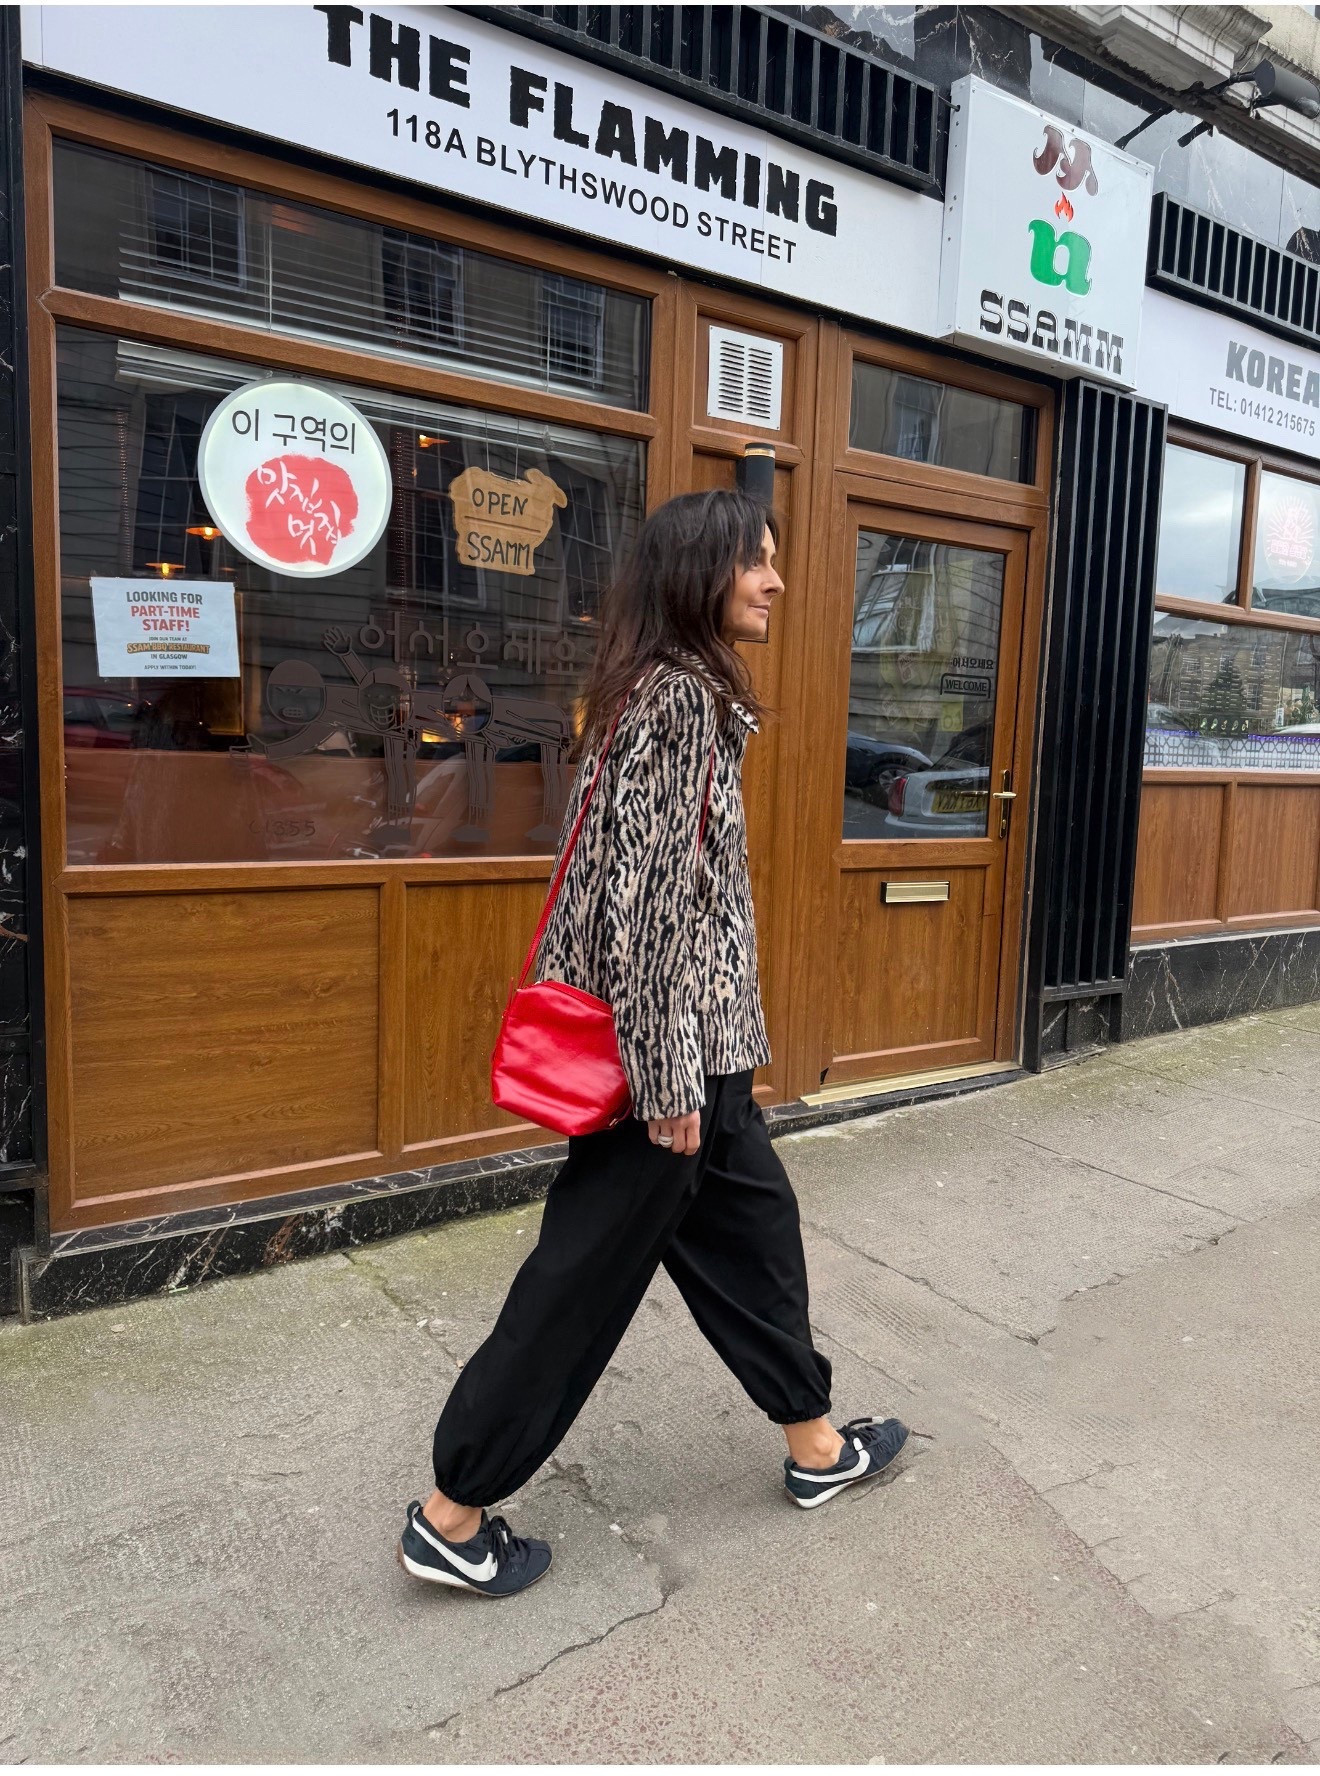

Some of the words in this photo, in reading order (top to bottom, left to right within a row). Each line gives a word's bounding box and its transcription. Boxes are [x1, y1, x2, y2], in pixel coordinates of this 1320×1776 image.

[313, 5, 471, 109] THE
[509, 65, 837, 237] FLAMMING
[387, 108, 467, 159] 118A
[476, 136, 690, 229] BLYTHSWOOD
[697, 212, 797, 264] STREET
[980, 289, 1125, 375] SSAMM
[1225, 340, 1320, 409] KOREA
[1209, 387, 1238, 412] TEL:
[1240, 397, 1275, 424] 01412
[1276, 409, 1316, 437] 215675
[231, 408, 260, 442] 이
[272, 413, 357, 455] 구역의
[471, 487, 529, 516] OPEN
[467, 531, 531, 570] SSAMM
[126, 591, 178, 603] LOOKING
[181, 593, 203, 605] FOR
[131, 605, 200, 619] PART-TIME
[142, 619, 190, 632] STAFF!
[127, 643, 151, 654] SSAM
[152, 642, 167, 652] BBQ
[168, 643, 211, 654] RESTAURANT
[952, 657, 994, 670] 어서오세요
[944, 678, 988, 692] WELCOME
